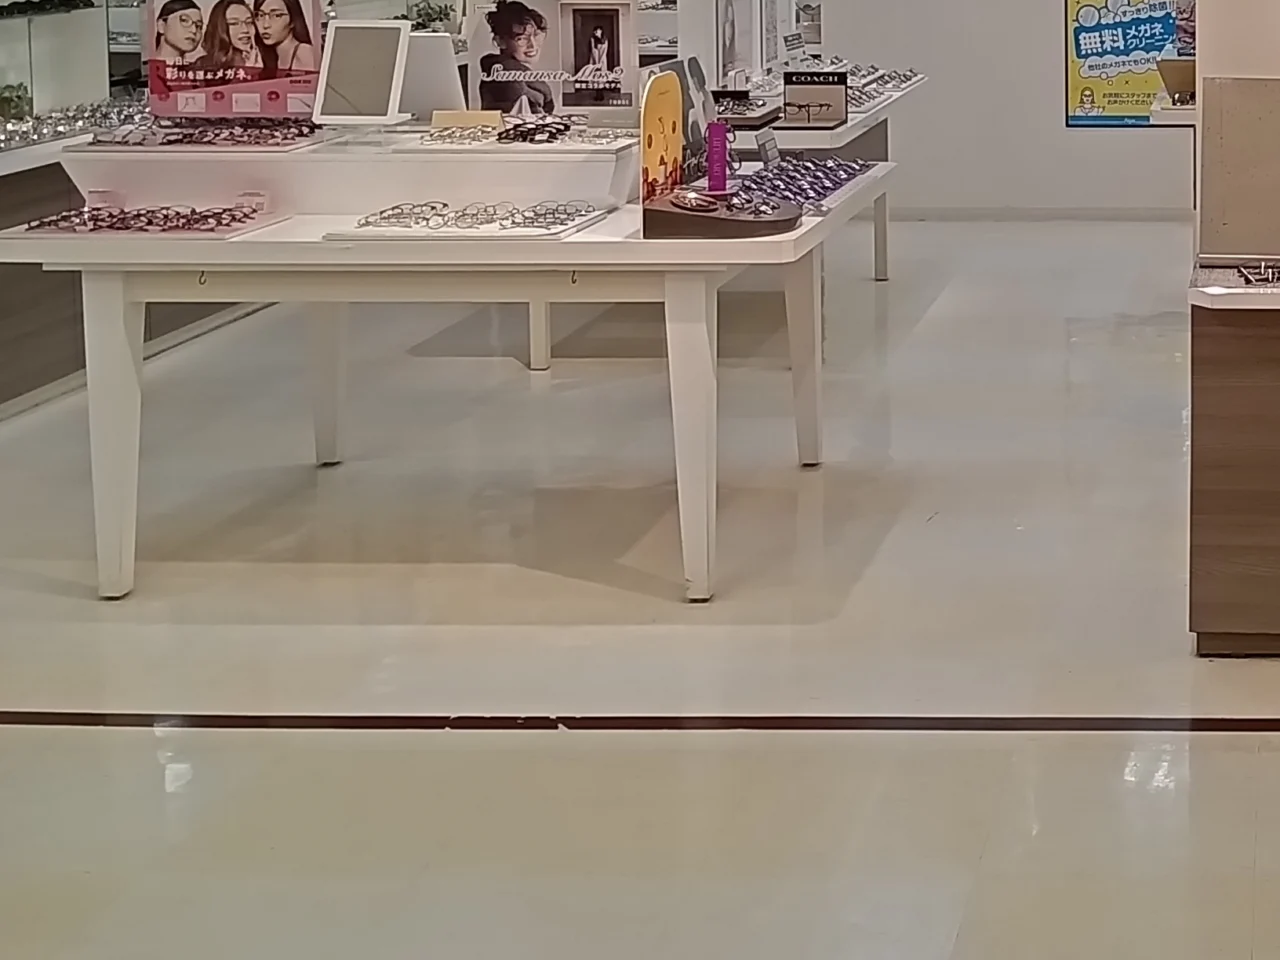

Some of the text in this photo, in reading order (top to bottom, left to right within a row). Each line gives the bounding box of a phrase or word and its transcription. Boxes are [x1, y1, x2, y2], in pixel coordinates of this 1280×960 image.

[1126, 23, 1164, 39] メガネ
[1079, 28, 1125, 54] 無料
[1126, 34, 1176, 48] クリーニン
[481, 63, 565, 81] Samansa
